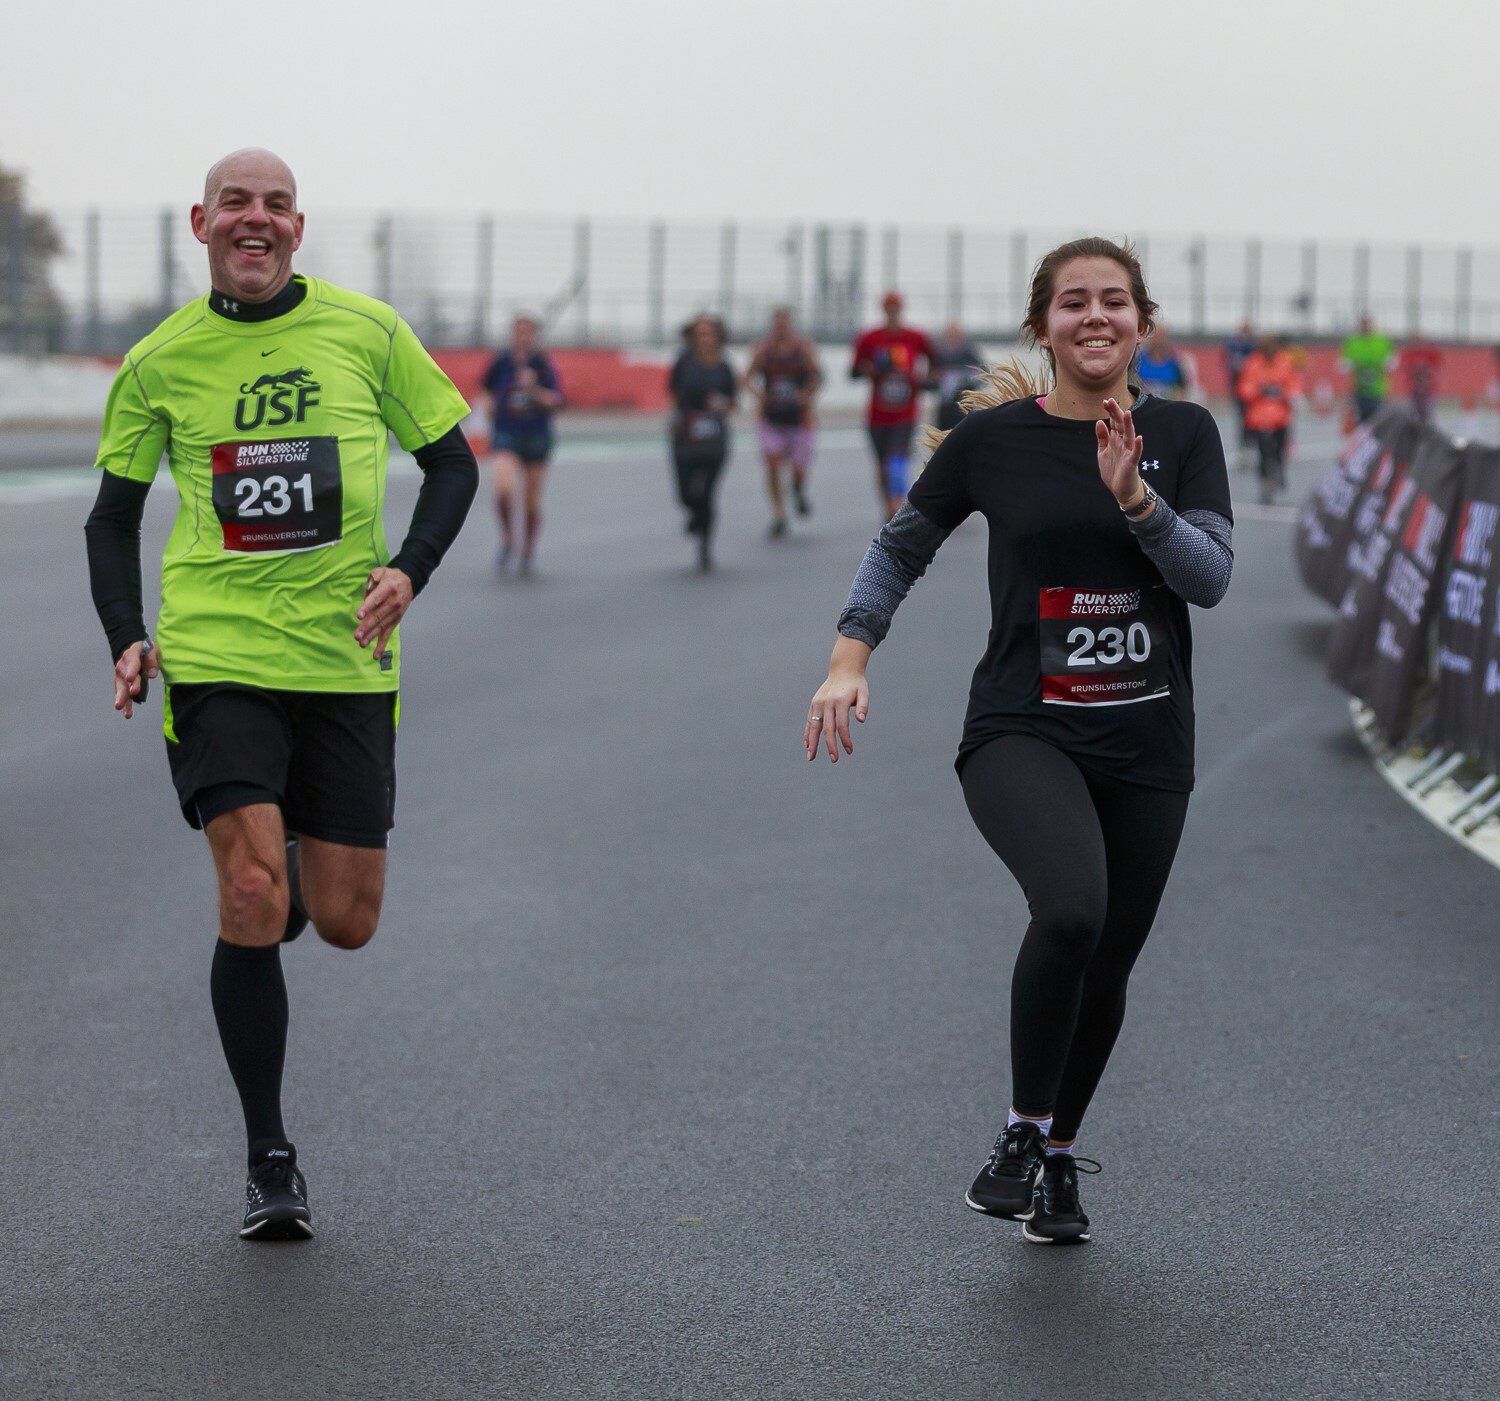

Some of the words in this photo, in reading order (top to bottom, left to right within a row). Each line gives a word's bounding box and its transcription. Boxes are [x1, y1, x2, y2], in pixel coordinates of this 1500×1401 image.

[234, 383, 323, 432] USF
[238, 445, 269, 457] RUN
[236, 452, 308, 466] SILVERSTONE
[235, 473, 314, 517] 231
[243, 529, 318, 542] #RUNSILVERSTONE
[1073, 594, 1106, 604] RUN
[1071, 602, 1138, 614] SILVERSTONE
[1066, 622, 1151, 666] 230
[1071, 680, 1146, 692] #RUNSILVERSTONE
